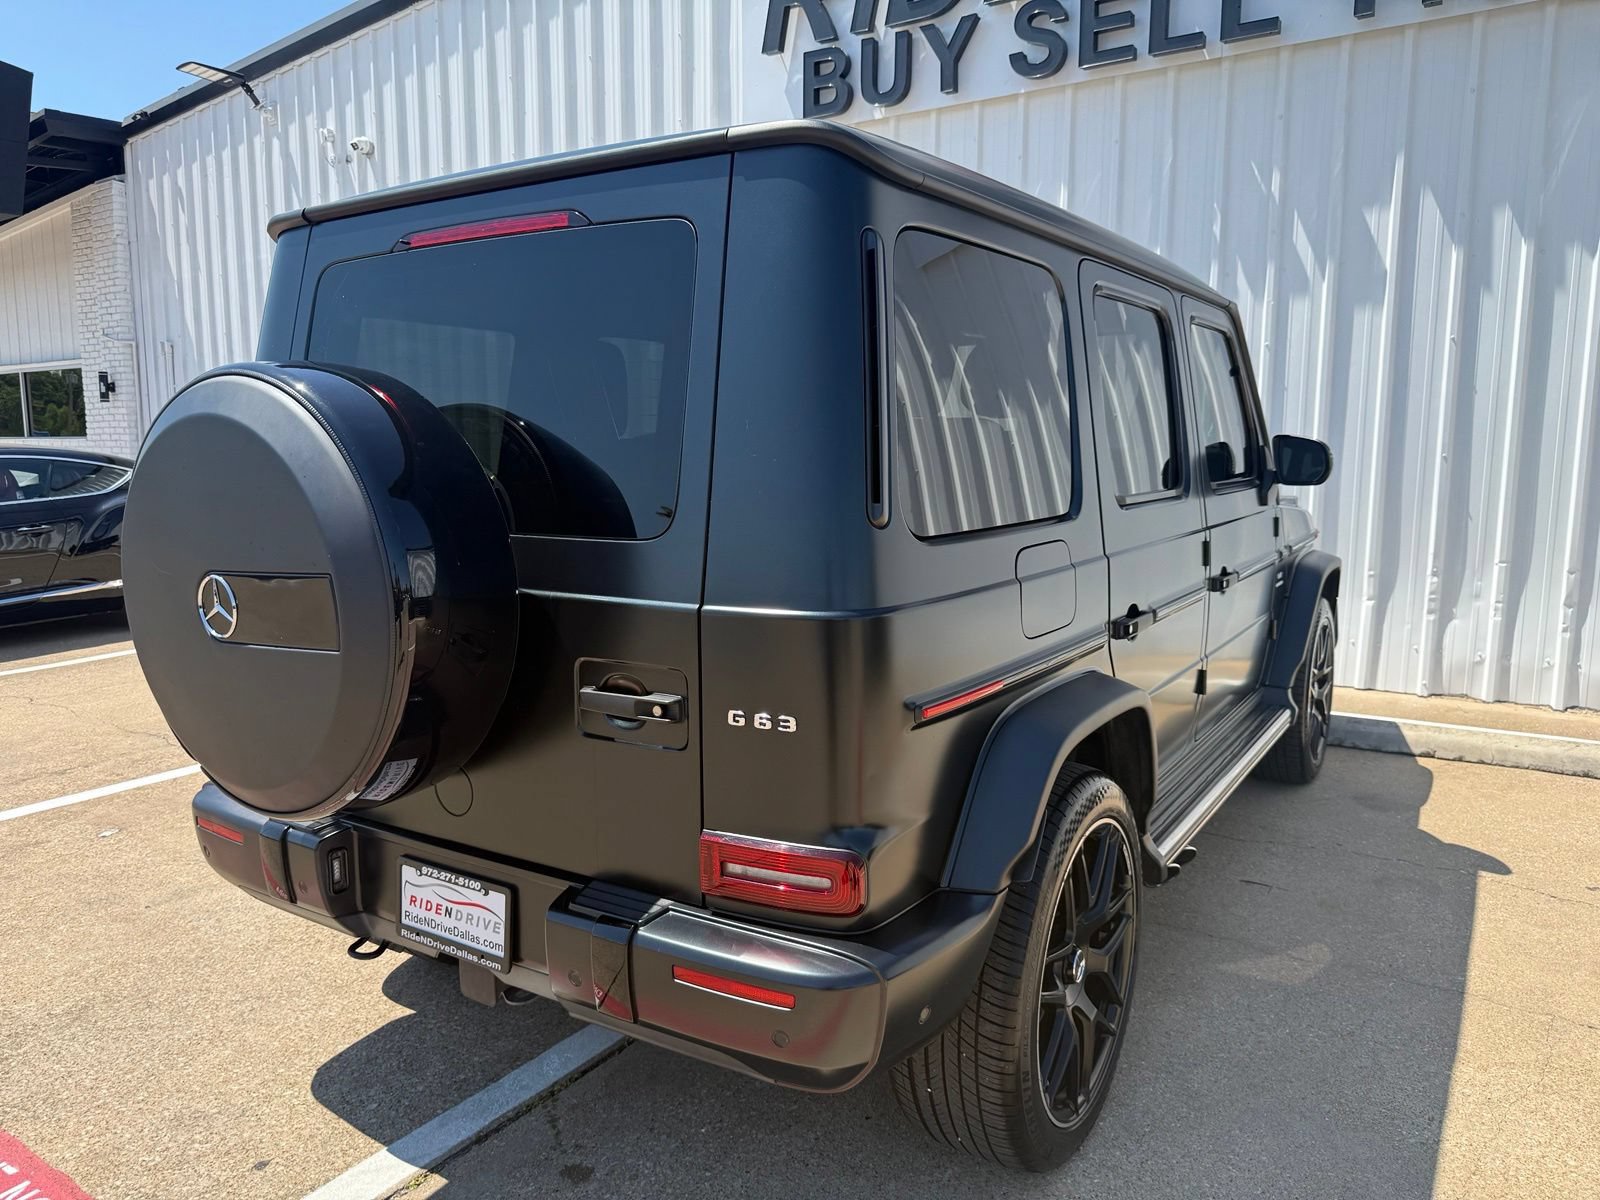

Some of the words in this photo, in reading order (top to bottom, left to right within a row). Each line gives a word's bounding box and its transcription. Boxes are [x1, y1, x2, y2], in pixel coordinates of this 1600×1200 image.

[803, 14, 981, 119] BUY
[1009, 0, 1281, 79] SELL
[421, 866, 481, 890] 972-271-5100
[401, 929, 501, 971] RideNDriveDallas.com
[404, 910, 504, 953] RideNDriveDallas.com
